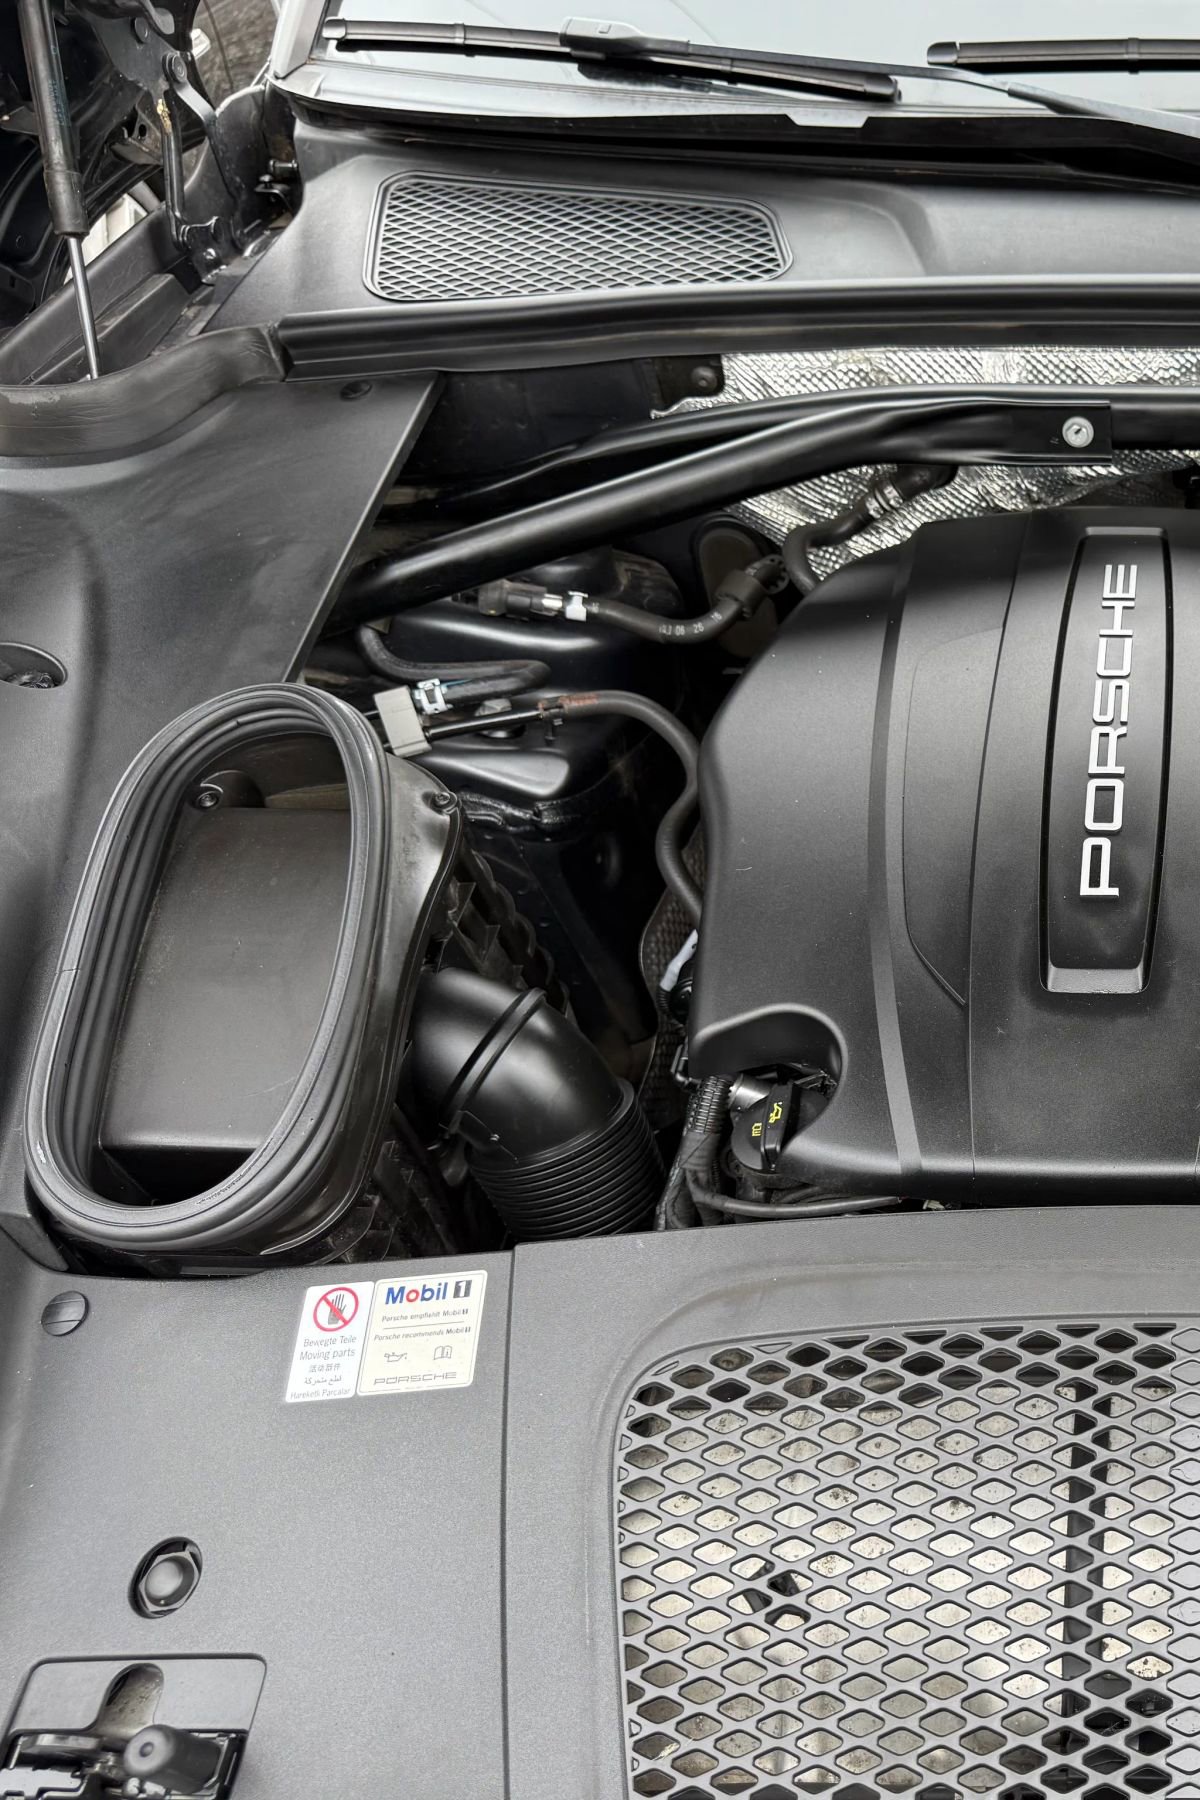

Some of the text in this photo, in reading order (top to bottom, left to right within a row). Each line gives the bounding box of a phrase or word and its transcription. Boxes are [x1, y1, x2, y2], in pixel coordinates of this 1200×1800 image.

[1079, 564, 1138, 897] PORSCHE
[385, 1282, 448, 1304] Mobil
[382, 1314, 408, 1323] Porsche
[303, 1335, 357, 1348] Bewegte Teile
[374, 1333, 401, 1341] Porsche
[402, 1329, 444, 1339] recommends
[299, 1348, 356, 1361] Moving parts
[373, 1371, 457, 1385] PORSCHE
